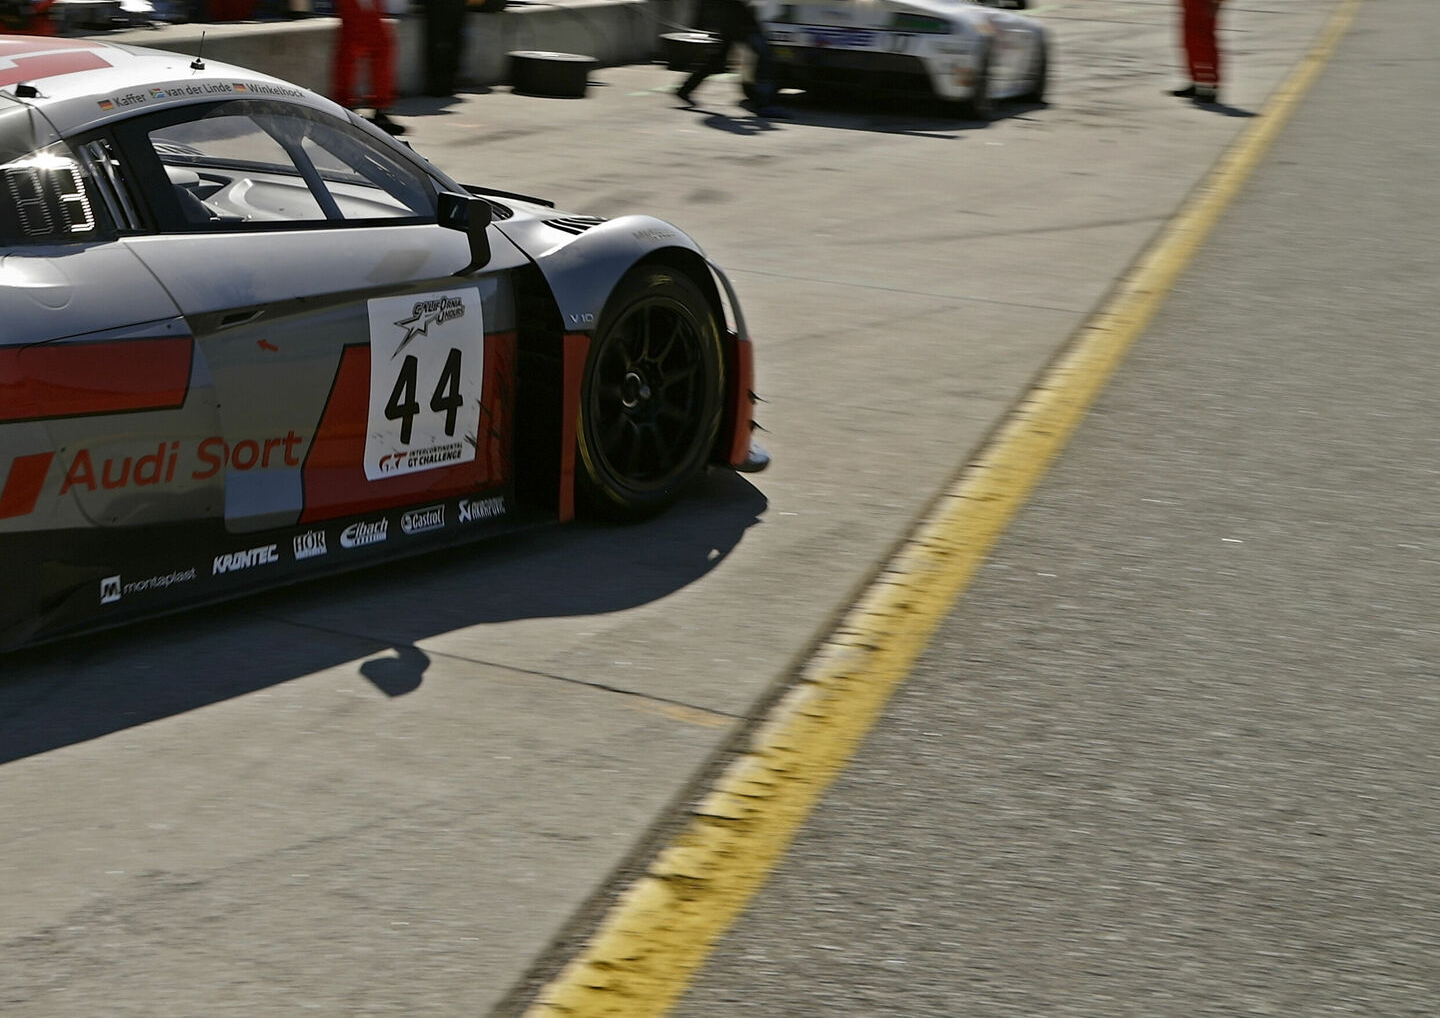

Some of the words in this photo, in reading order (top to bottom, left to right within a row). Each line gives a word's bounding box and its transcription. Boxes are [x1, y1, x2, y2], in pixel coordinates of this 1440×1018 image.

[113, 93, 147, 108] Kaffer
[165, 88, 185, 97] van
[186, 86, 203, 95] der
[206, 82, 232, 93] Linde
[246, 83, 305, 98] Winkelhock
[384, 348, 463, 445] 44
[409, 443, 463, 456] INTERCONTINENTAL
[418, 449, 462, 466] CHALLENGE
[59, 441, 180, 495] Audi
[412, 509, 442, 529] Castrol
